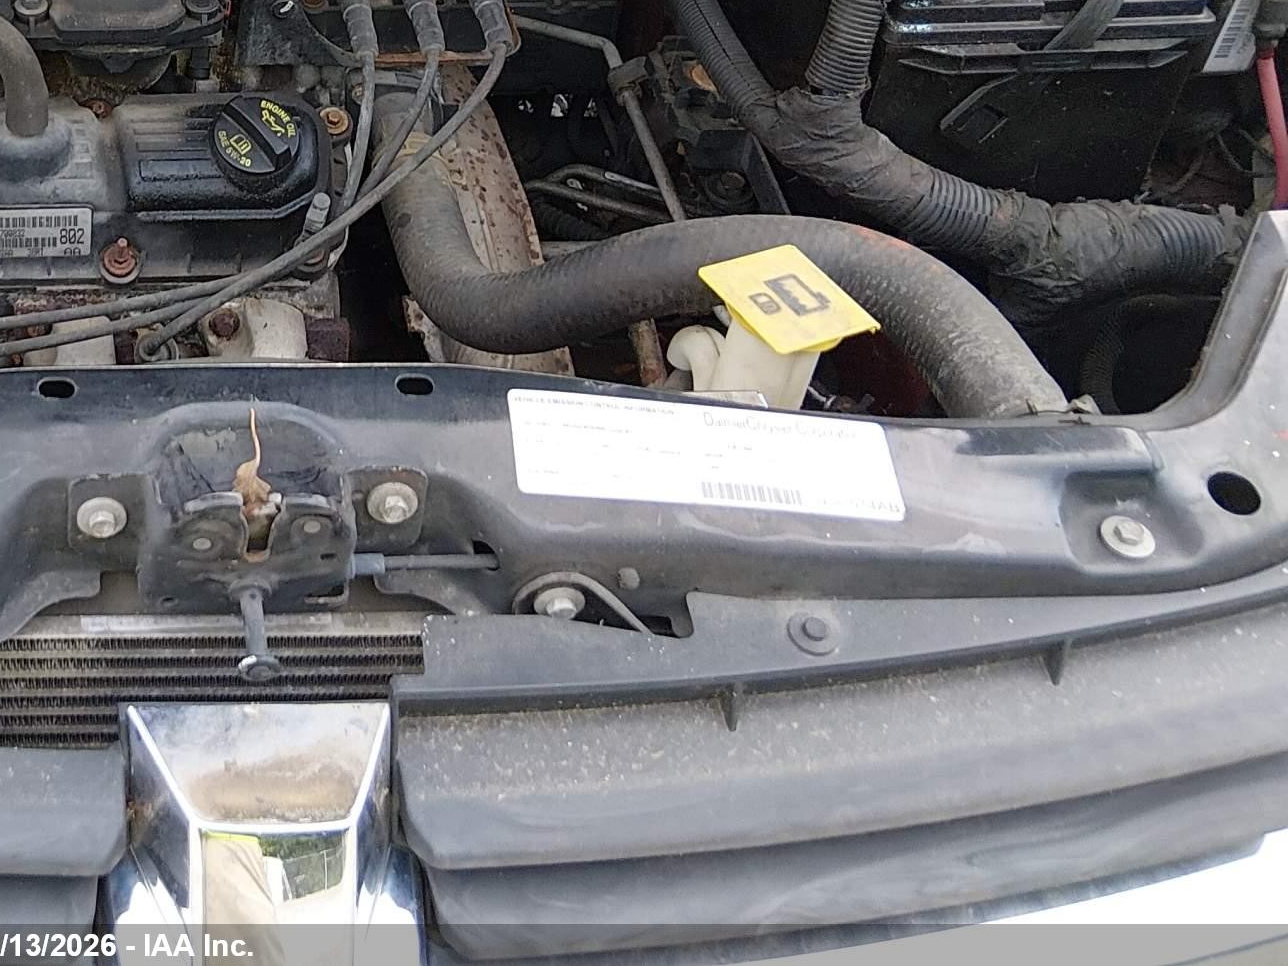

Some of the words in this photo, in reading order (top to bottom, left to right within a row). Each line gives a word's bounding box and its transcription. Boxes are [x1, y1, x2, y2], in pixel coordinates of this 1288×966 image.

[260, 100, 291, 123] ENGINE
[286, 122, 297, 138] OIL
[218, 130, 230, 148] SAE
[225, 146, 253, 167] 5W-20
[59, 228, 85, 245] 802
